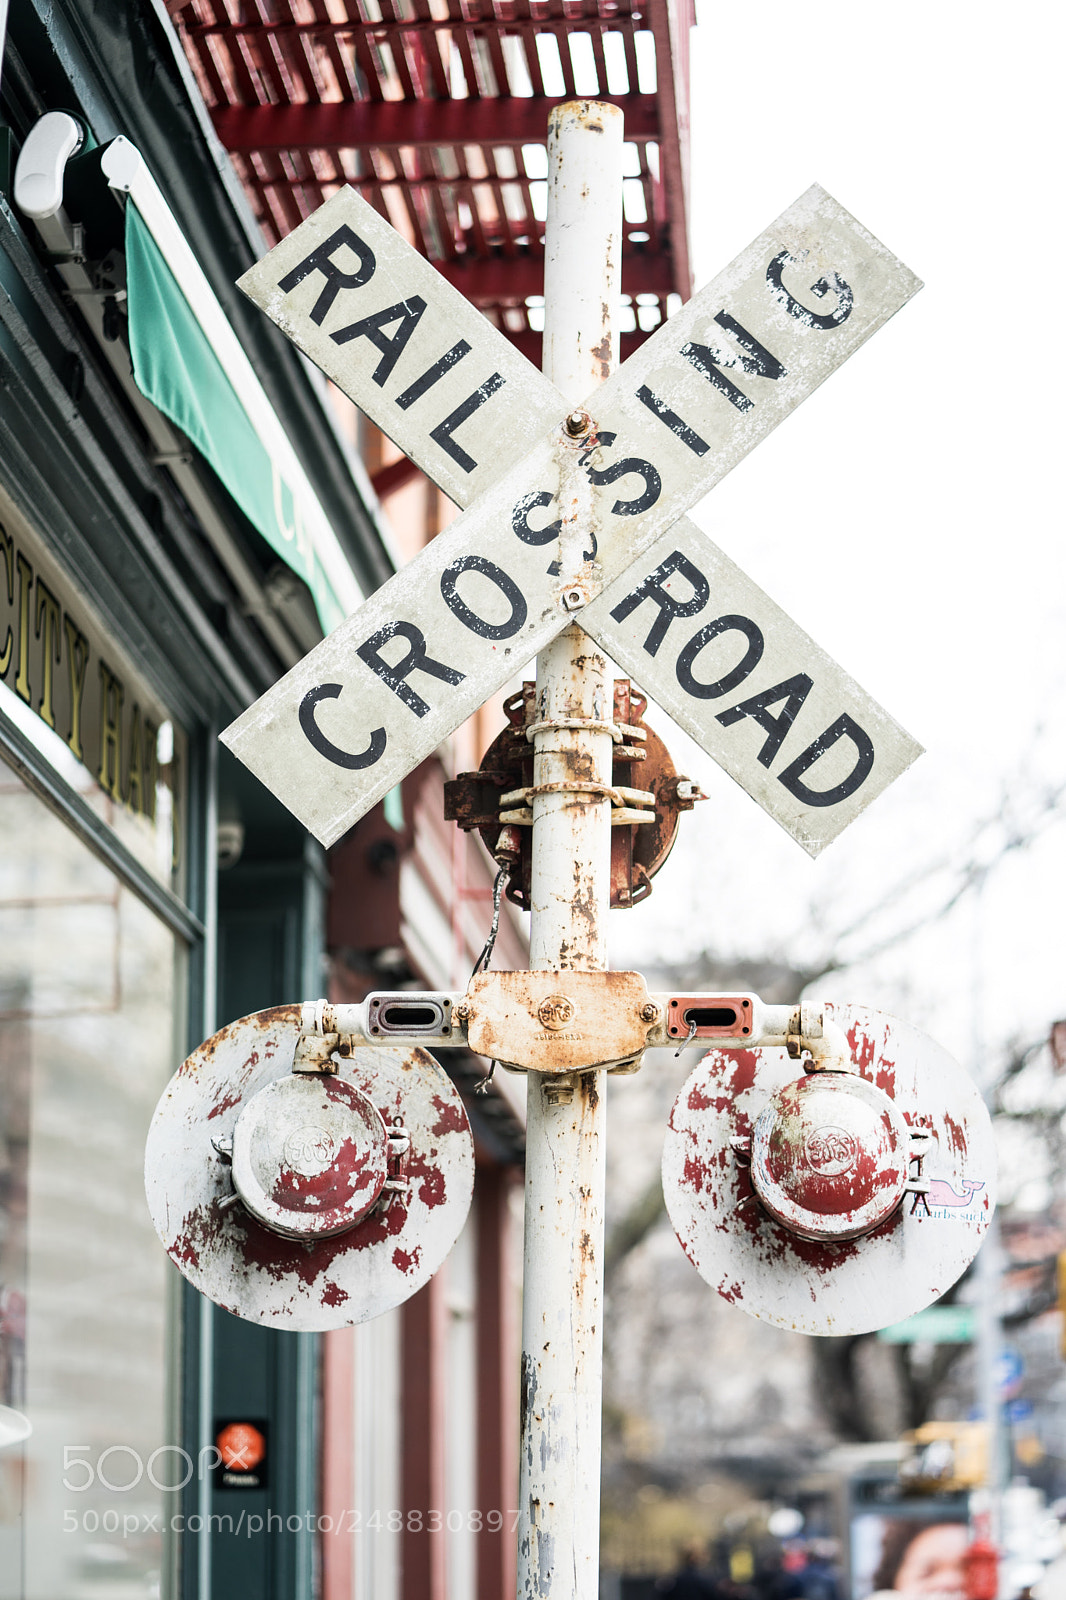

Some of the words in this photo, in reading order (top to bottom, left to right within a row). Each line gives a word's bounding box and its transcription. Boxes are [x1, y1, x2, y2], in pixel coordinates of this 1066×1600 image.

[278, 224, 506, 473] RAIL
[609, 550, 874, 806] ROAD
[299, 249, 854, 769] CROSSING
[909, 1207, 956, 1219] uurbs
[960, 1211, 986, 1222] suck
